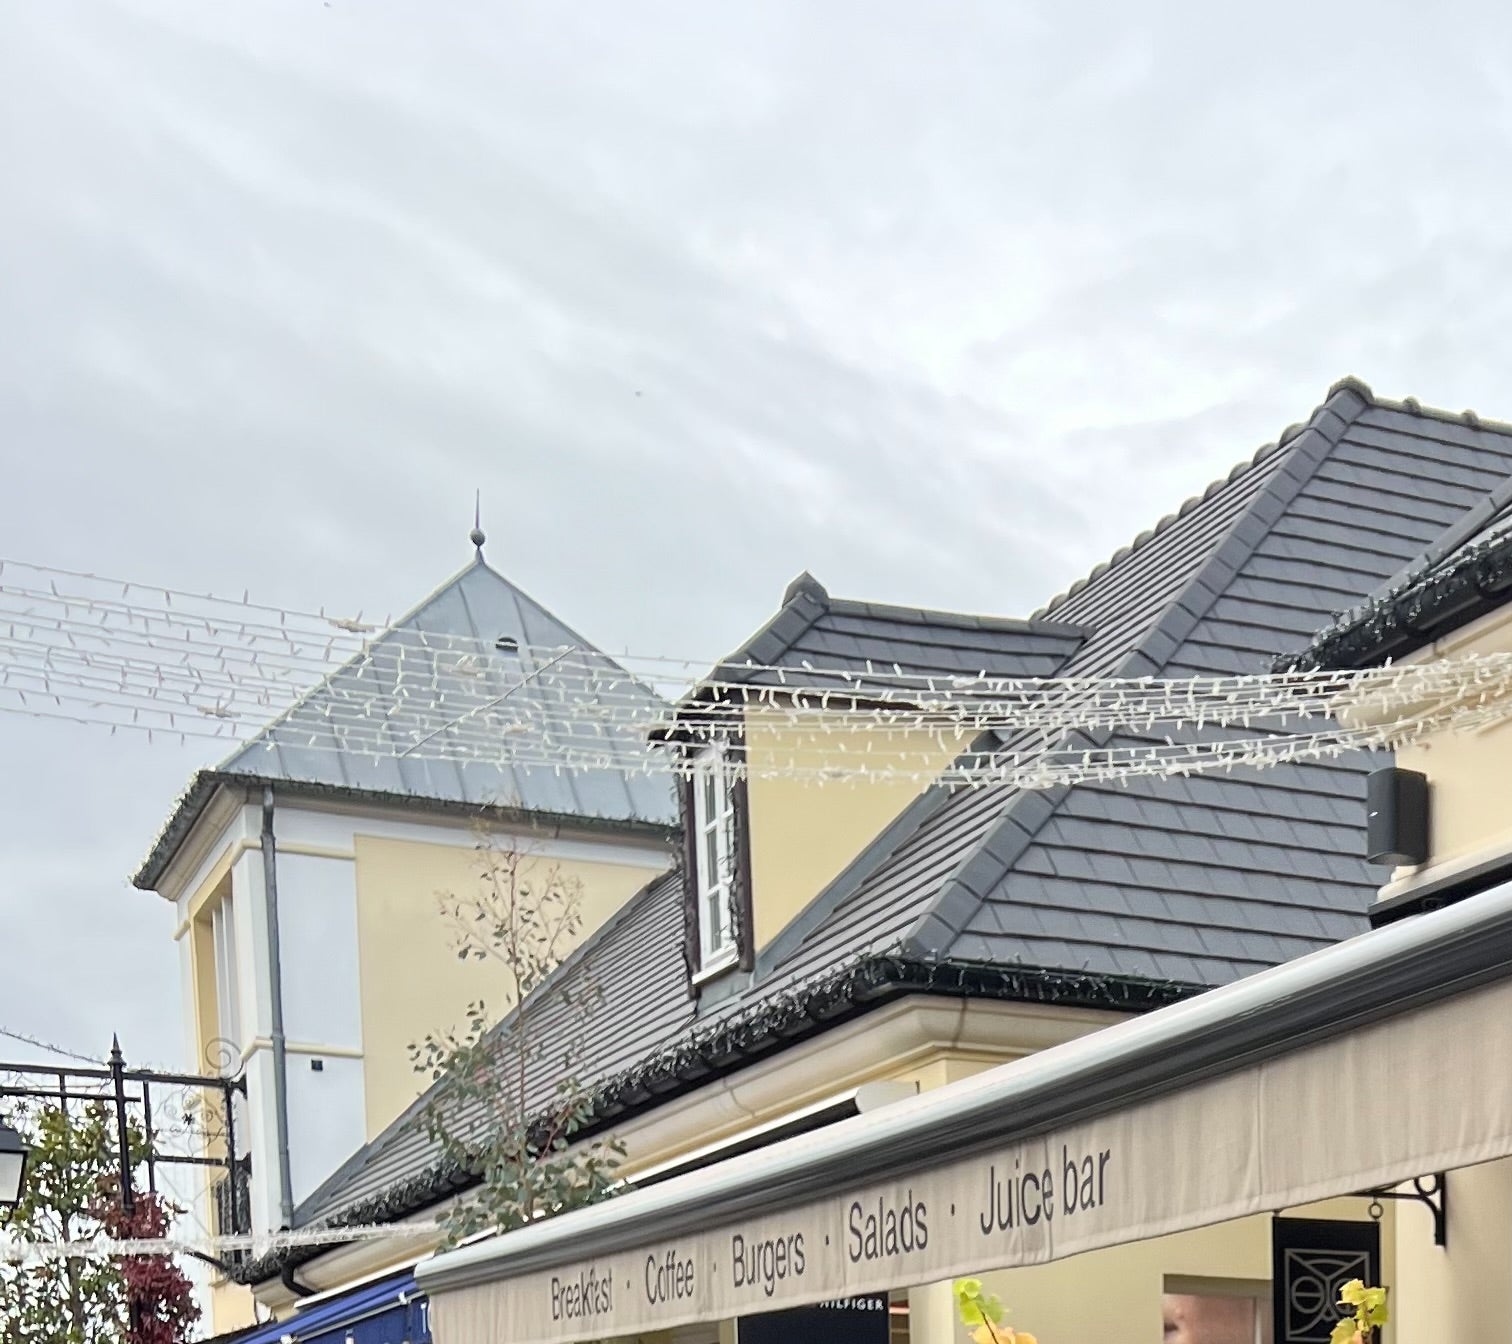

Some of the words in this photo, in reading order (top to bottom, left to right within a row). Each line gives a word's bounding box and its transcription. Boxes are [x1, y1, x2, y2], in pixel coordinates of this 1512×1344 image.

[645, 1250, 694, 1305] Coffee
[732, 1232, 806, 1297] Burgers
[849, 1189, 928, 1263] Salads
[980, 1158, 1054, 1236] Juice
[1063, 1144, 1110, 1217] bar
